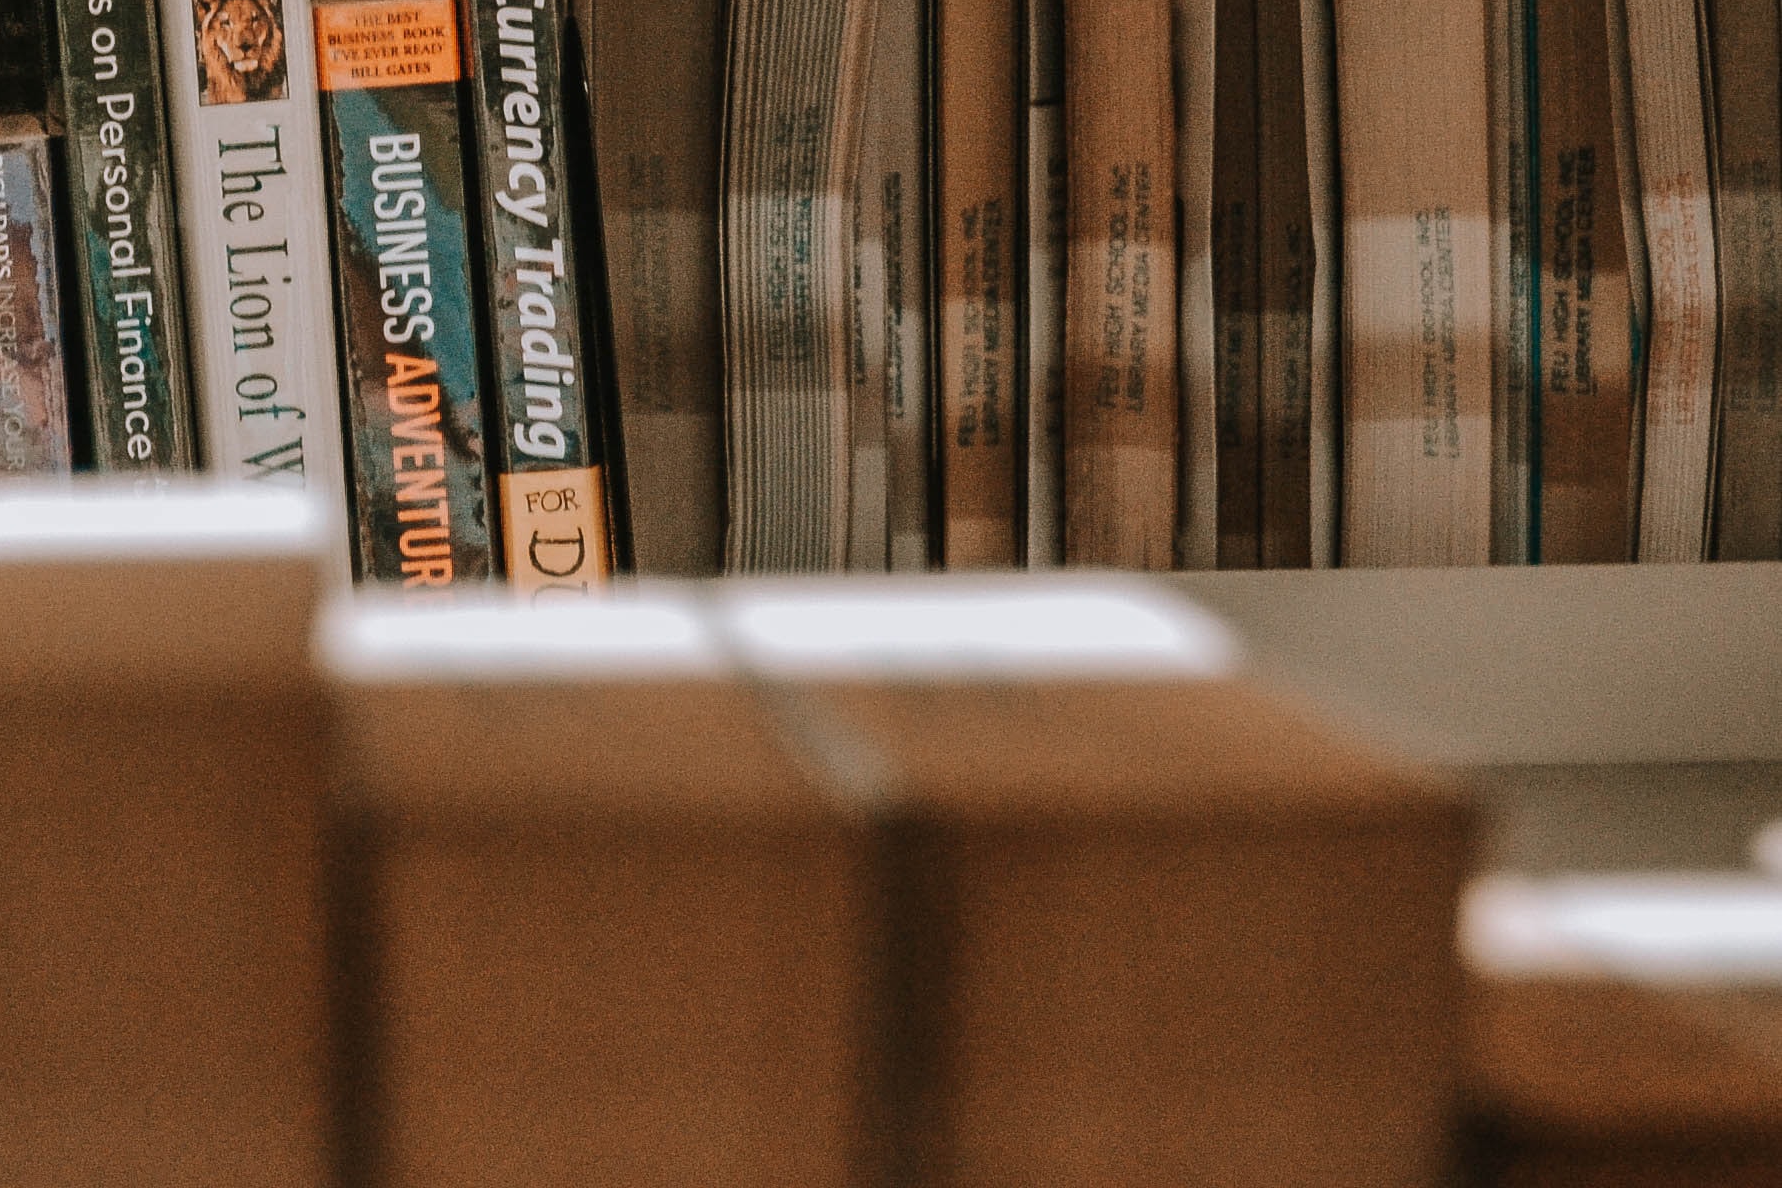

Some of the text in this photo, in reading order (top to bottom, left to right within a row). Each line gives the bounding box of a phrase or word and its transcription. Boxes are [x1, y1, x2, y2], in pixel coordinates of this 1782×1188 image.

[91, 26, 119, 81] on
[386, 10, 421, 24] BEST
[403, 26, 445, 41] BOOK
[97, 91, 152, 279] Personal
[369, 132, 436, 345] BUSINESS
[217, 123, 307, 423] The Lion of
[513, 237, 576, 460] Trading
[114, 290, 154, 460] Finance
[525, 487, 582, 513] FOR
